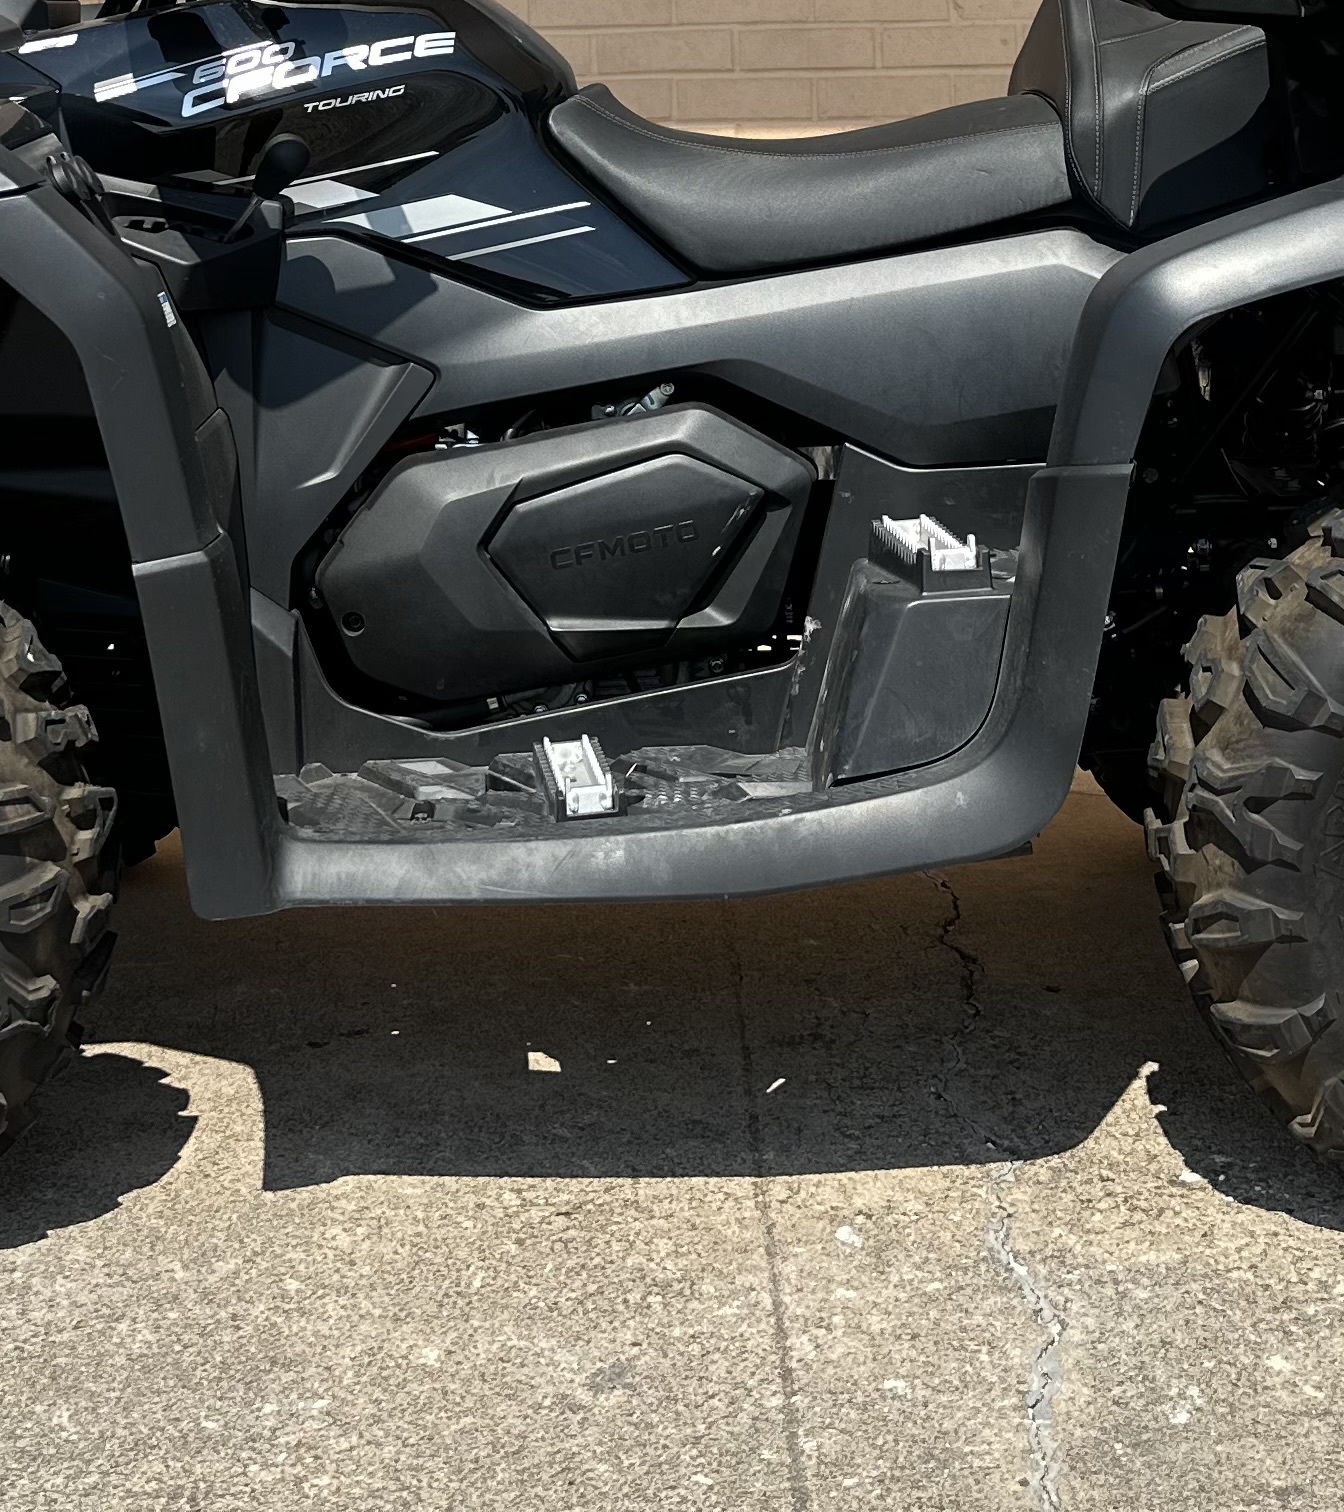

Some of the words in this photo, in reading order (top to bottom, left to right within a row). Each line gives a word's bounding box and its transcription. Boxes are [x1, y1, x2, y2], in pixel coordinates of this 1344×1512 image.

[180, 31, 457, 119] CFORCE
[192, 41, 296, 85] 600
[302, 84, 407, 114] TOURING
[549, 519, 700, 571] CFMOTO
